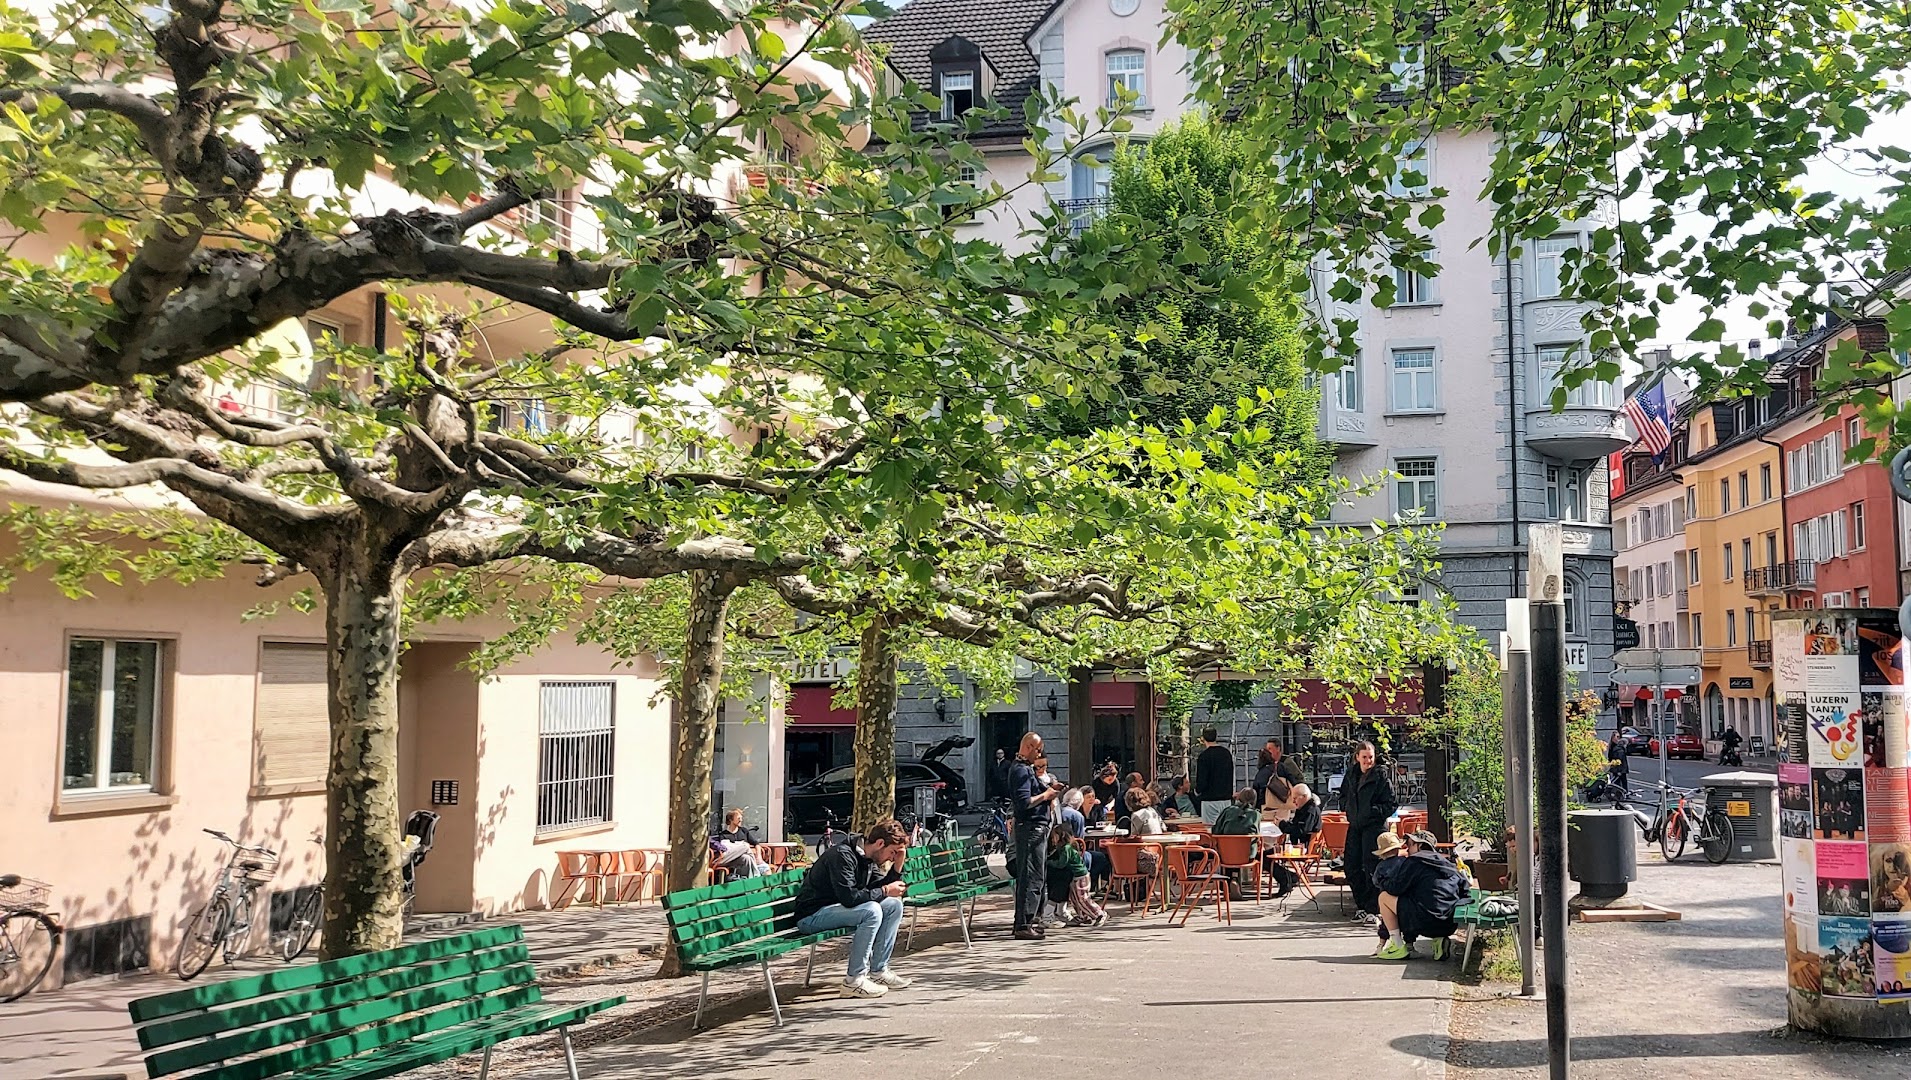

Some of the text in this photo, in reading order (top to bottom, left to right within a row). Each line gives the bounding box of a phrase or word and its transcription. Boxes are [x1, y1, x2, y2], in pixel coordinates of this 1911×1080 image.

[1565, 644, 1585, 665] AFÉ
[789, 662, 843, 679] OTEL
[1810, 695, 1849, 704] LUZERN
[1811, 705, 1843, 713] TANZT
